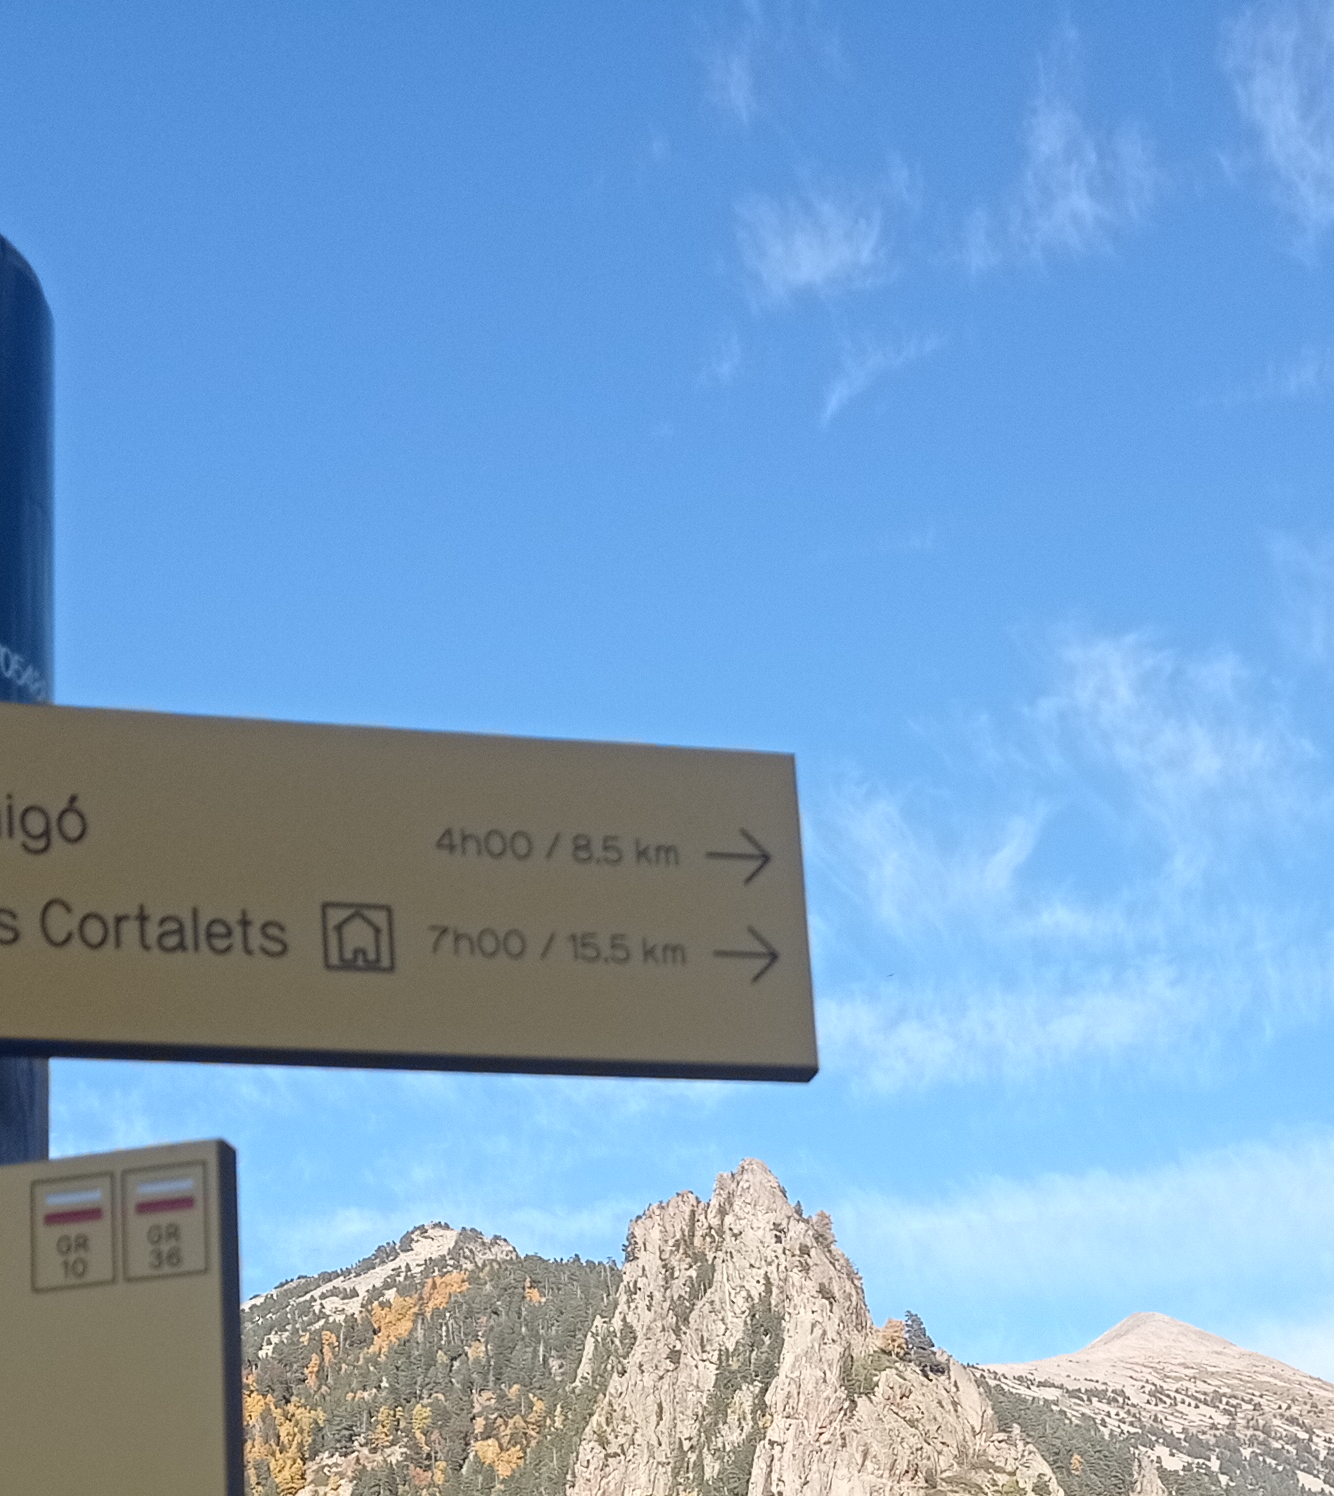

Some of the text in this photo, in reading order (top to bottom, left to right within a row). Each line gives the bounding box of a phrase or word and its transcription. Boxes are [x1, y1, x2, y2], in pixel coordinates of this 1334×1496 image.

[434, 826, 680, 867] 4h00 / 8.5 km
[38, 897, 289, 959] Cortalets
[427, 923, 687, 967] 7h00 / 15.5 km
